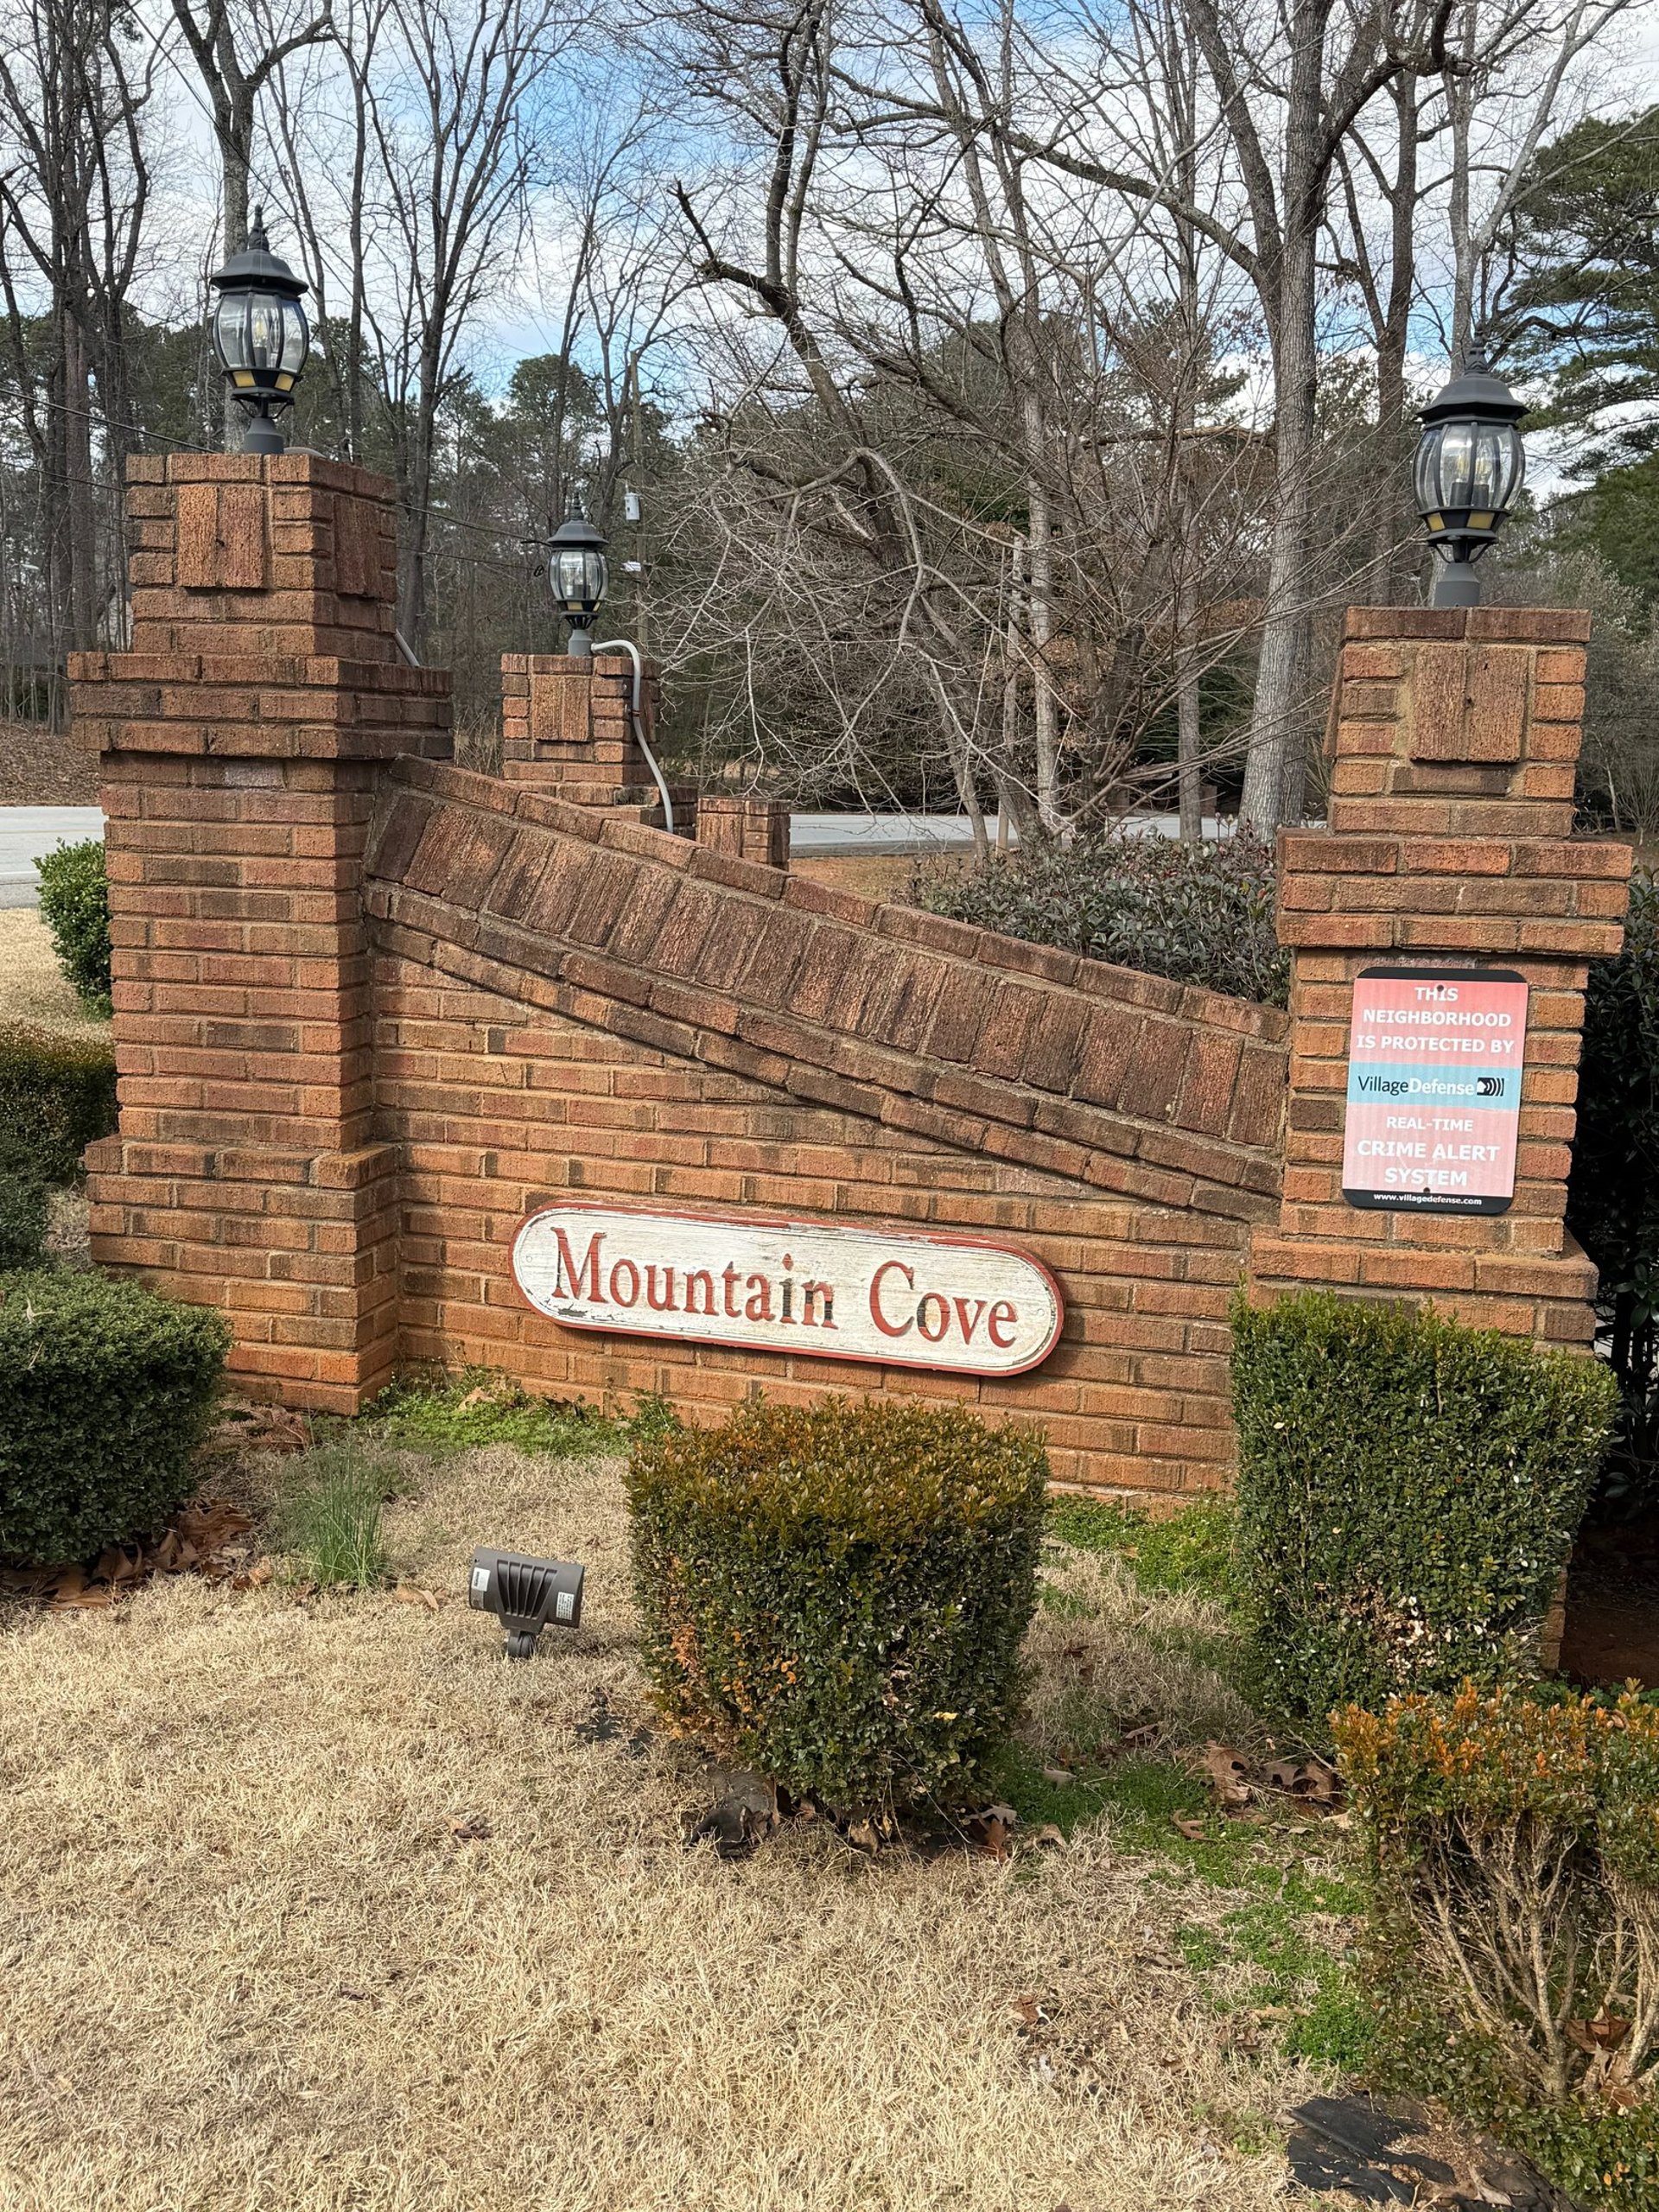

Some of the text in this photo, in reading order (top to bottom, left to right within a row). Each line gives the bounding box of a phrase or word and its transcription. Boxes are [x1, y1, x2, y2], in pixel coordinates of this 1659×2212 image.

[1414, 987, 1459, 1001] THIS
[1363, 1009, 1511, 1027] NEIGHBORHOOD
[1357, 1035, 1515, 1053] IS PROTECTED BY
[1357, 1076, 1475, 1096] VillageDefense
[1386, 1116, 1473, 1132] REAL-TIME
[1357, 1140, 1501, 1162] CRIME ALERT
[1384, 1167, 1467, 1186] SYSTEM
[1373, 1192, 1483, 1206] www.villagedefense.com
[550, 1227, 1019, 1349] Mountain Cove
